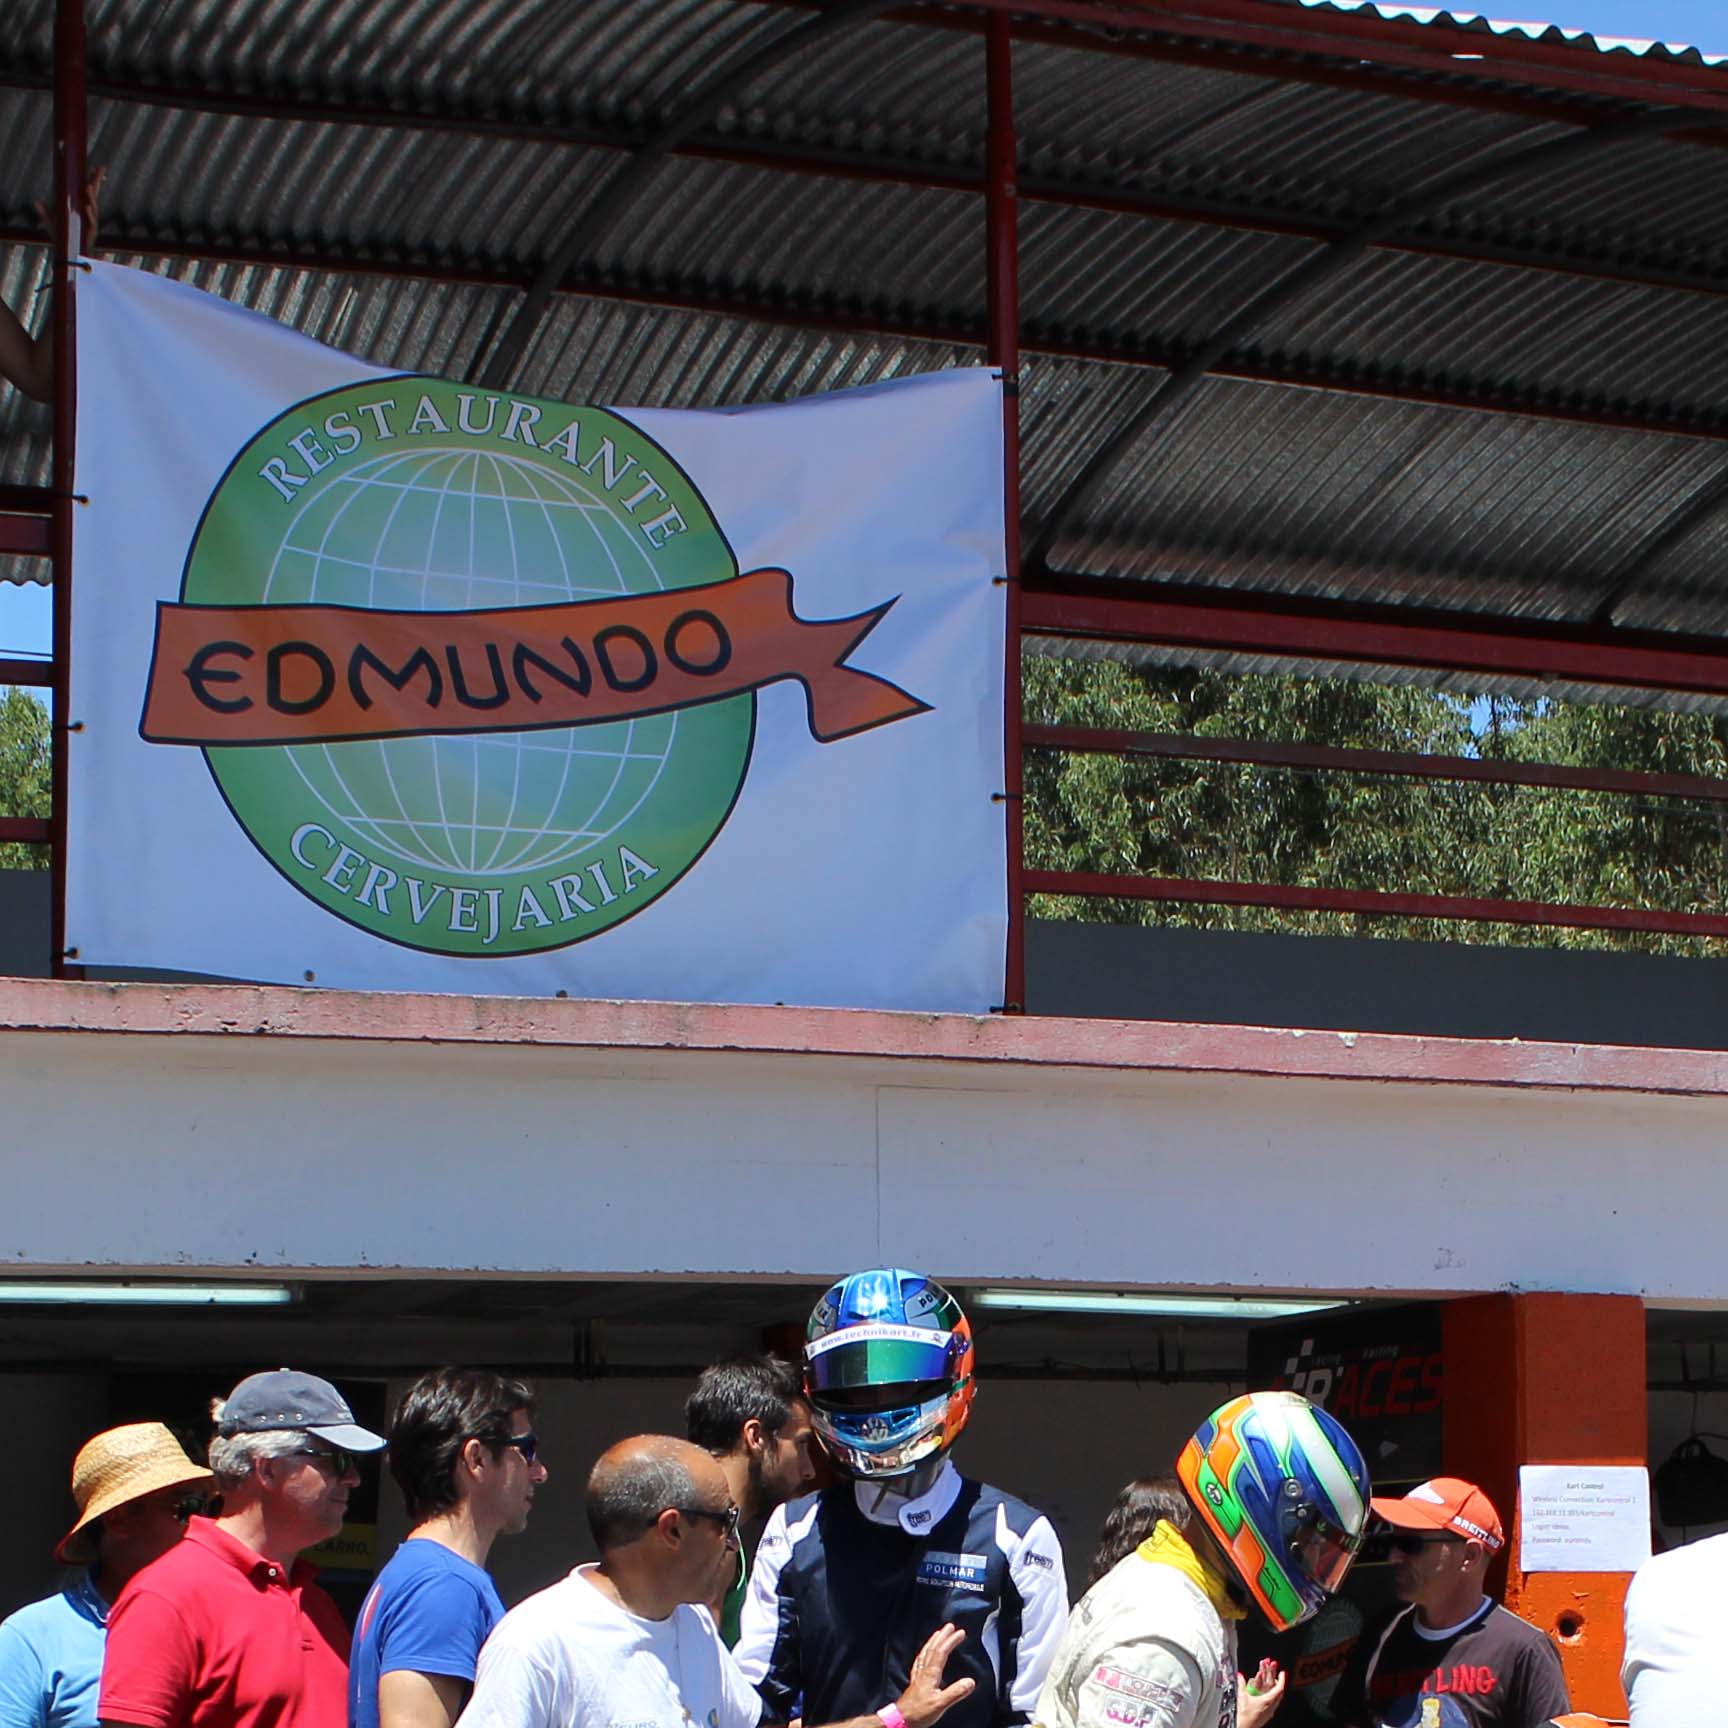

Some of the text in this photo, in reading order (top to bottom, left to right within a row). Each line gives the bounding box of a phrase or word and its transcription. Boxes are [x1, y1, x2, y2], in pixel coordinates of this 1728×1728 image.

[258, 392, 687, 548] RESTAURANTE
[183, 608, 732, 713] EDMUNDO
[289, 821, 659, 944] CERVEJARIA
[925, 1563, 976, 1578] POLMAR
[1453, 1515, 1501, 1549] BREITLING
